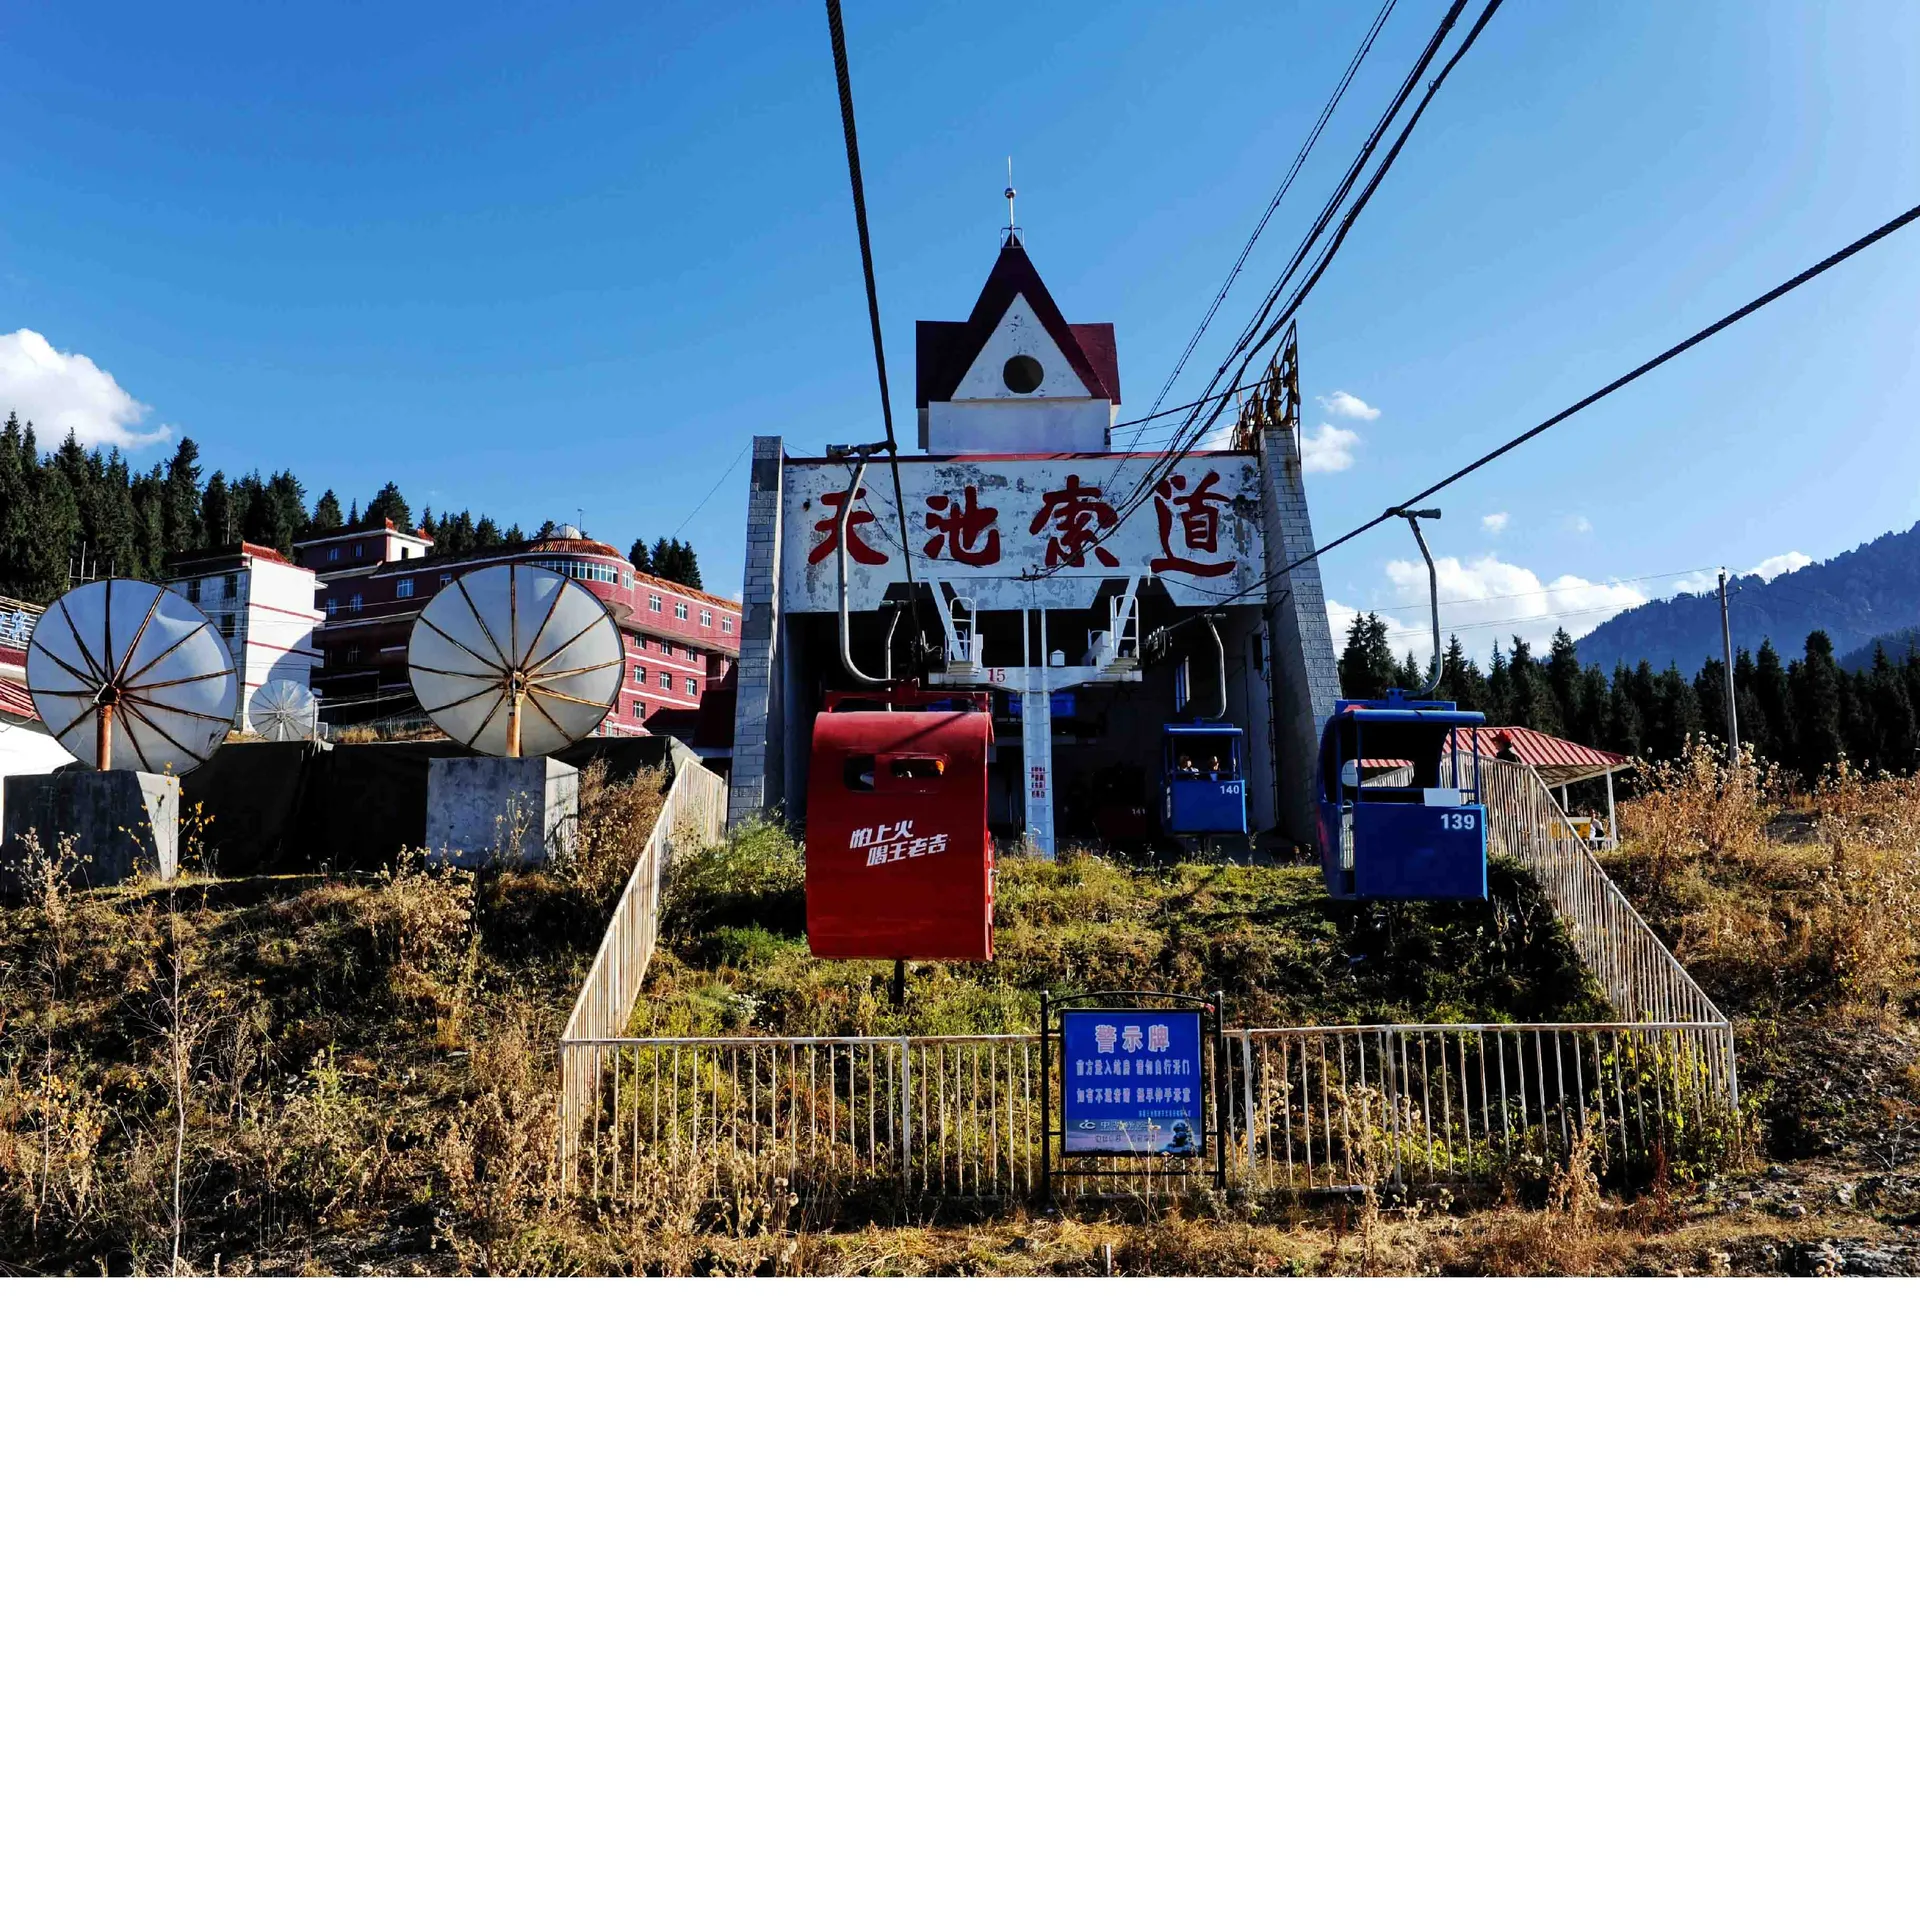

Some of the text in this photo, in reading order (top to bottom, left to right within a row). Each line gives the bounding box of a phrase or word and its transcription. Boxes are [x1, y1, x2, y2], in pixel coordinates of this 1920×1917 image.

[808, 472, 1236, 577] 天池索道
[987, 668, 1006, 682] 15
[1219, 785, 1240, 795] 140
[849, 820, 914, 849] 怕上火
[1440, 813, 1475, 830] 139
[866, 834, 949, 867] 喝王老吉
[1095, 1024, 1170, 1053] 警示牌
